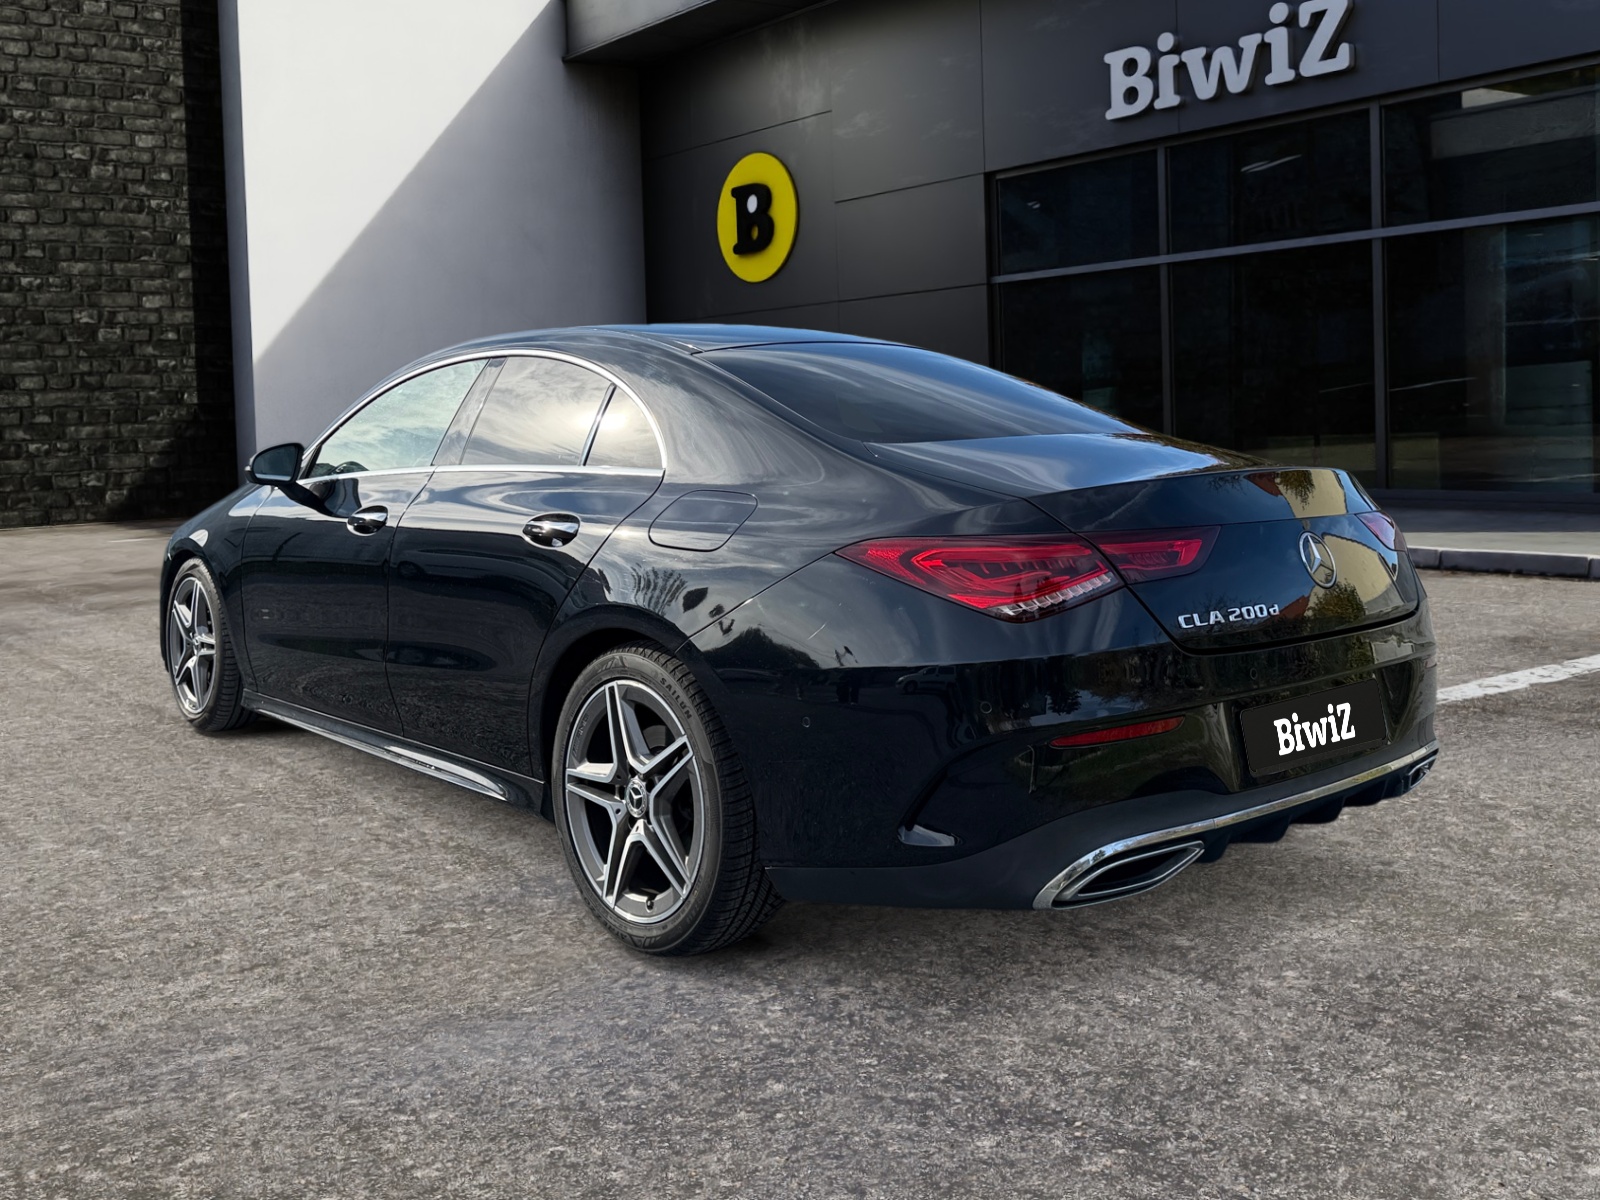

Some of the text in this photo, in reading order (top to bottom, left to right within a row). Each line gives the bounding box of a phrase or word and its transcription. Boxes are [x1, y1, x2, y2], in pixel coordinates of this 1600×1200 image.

[1103, 0, 1351, 121] BiwiZ
[730, 182, 775, 256] B
[1177, 610, 1226, 629] CLA
[659, 677, 692, 719] SAILUN
[1273, 702, 1356, 756] BiwiZ
